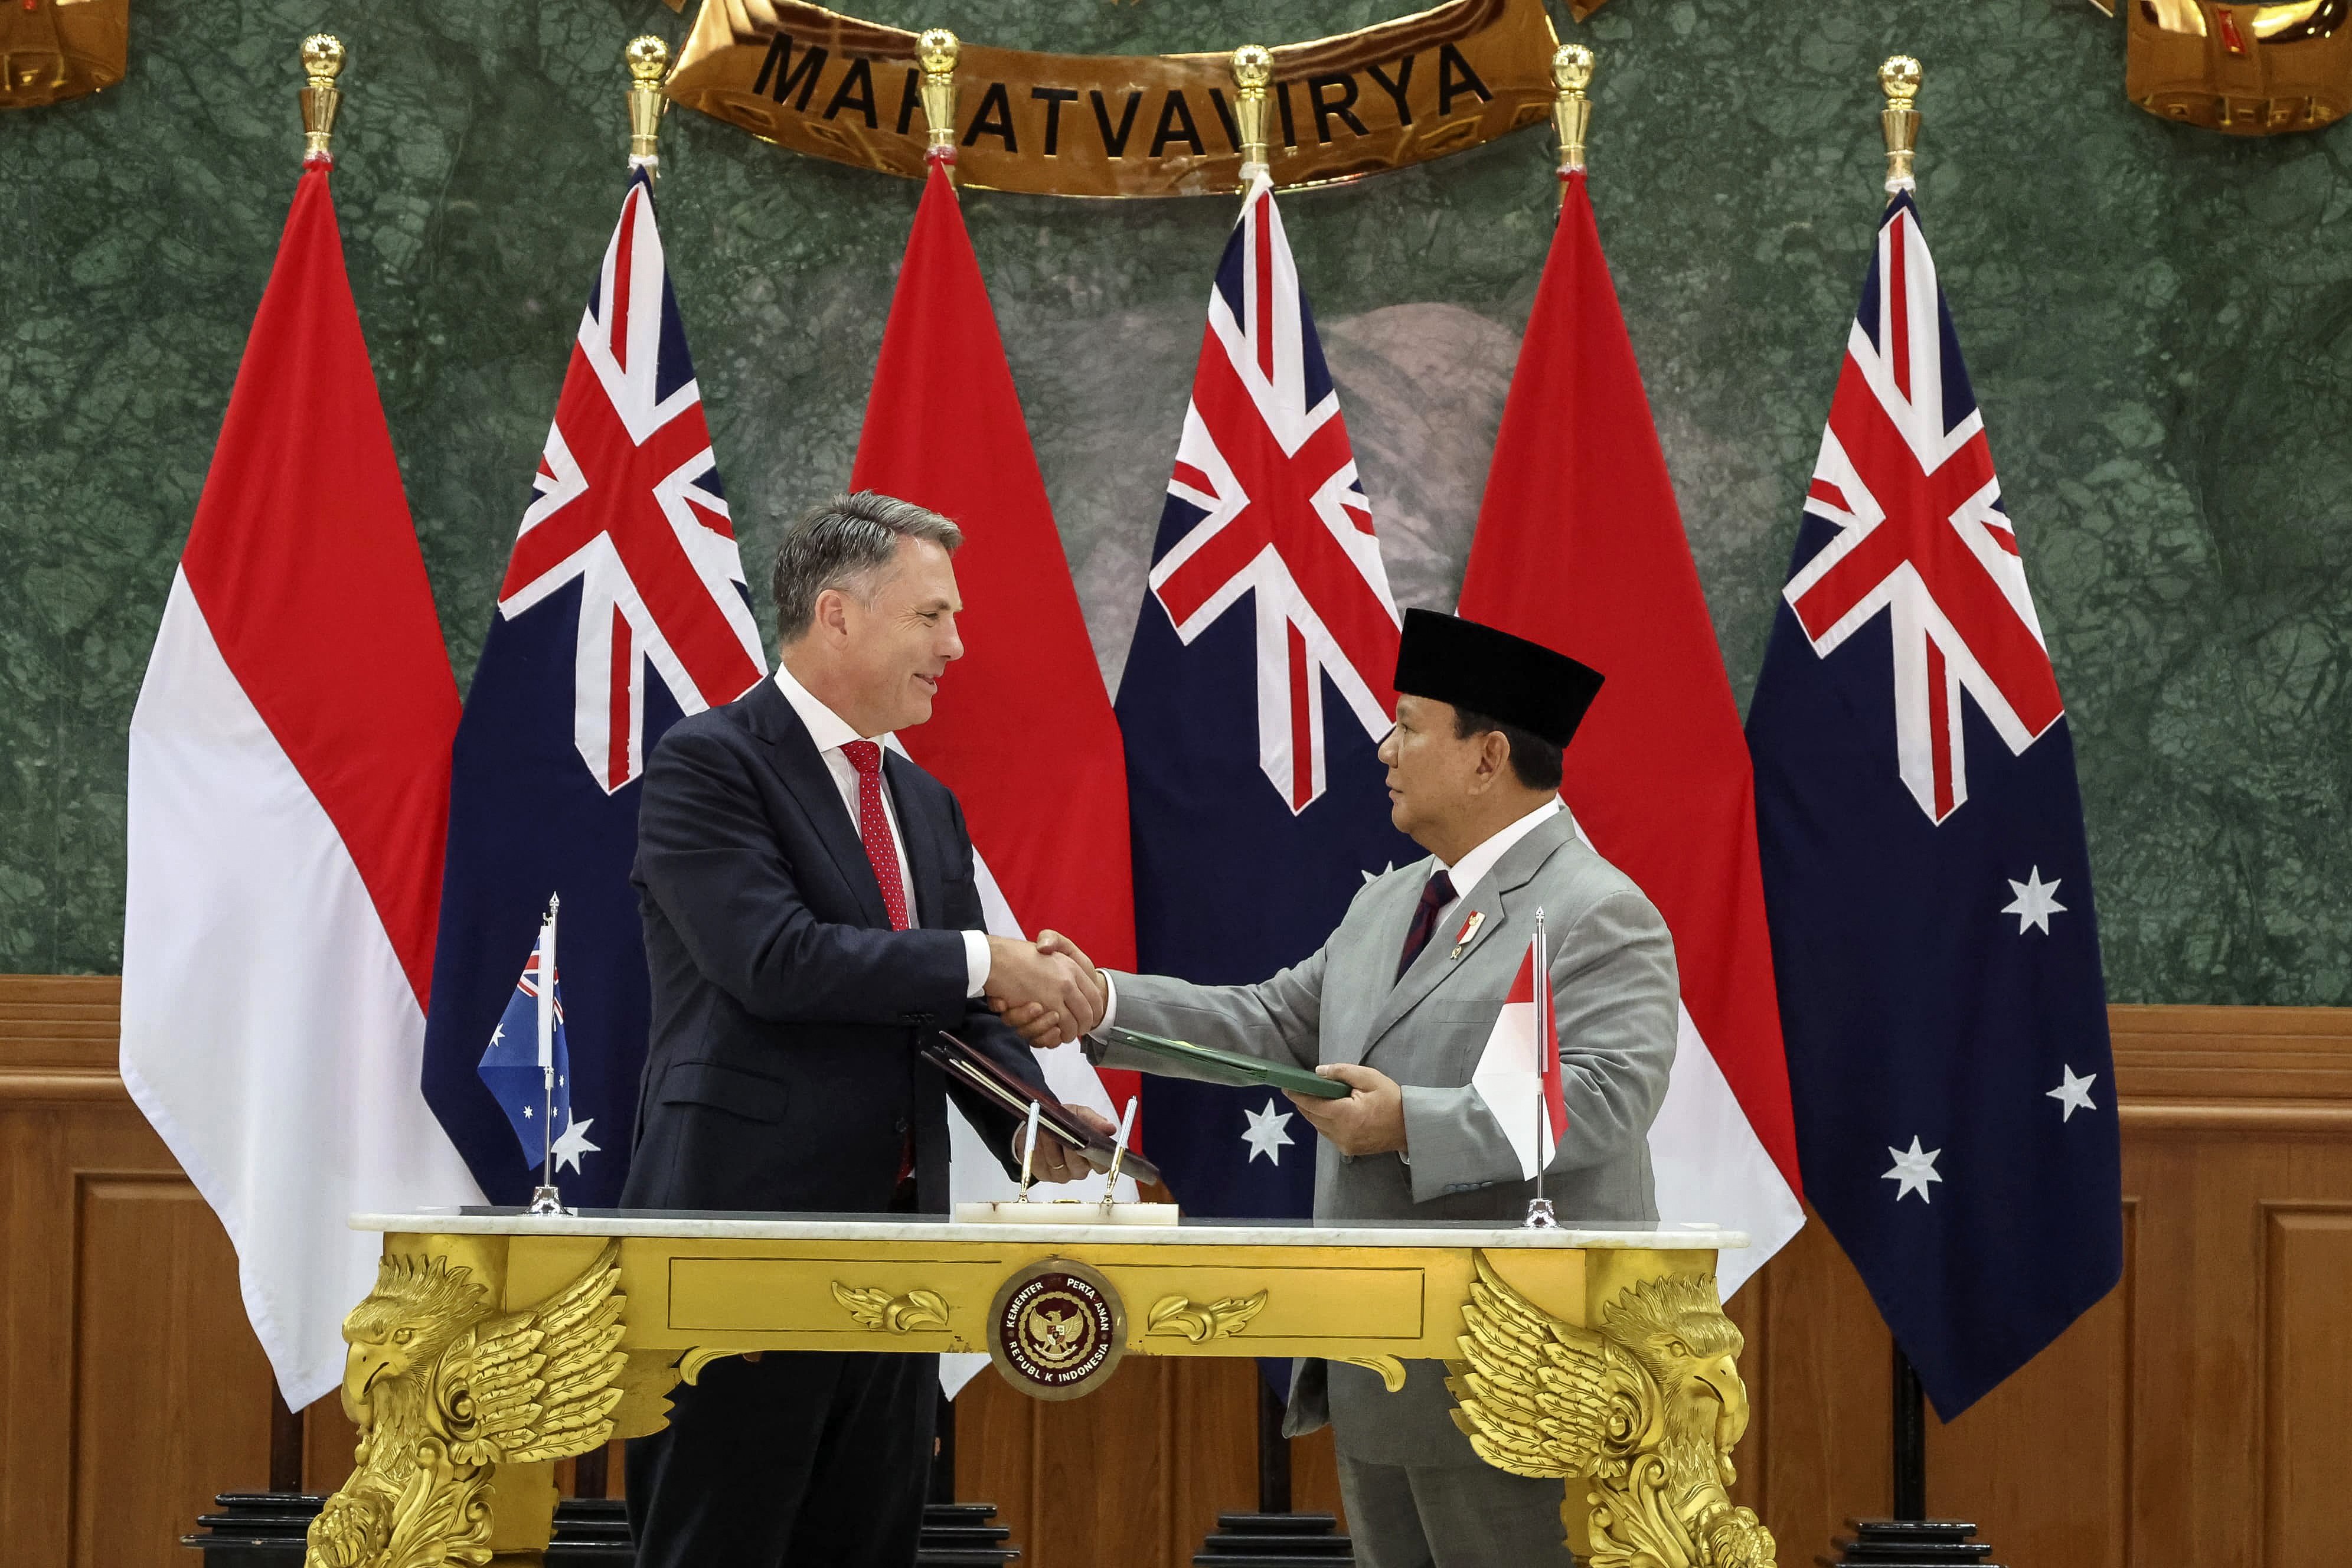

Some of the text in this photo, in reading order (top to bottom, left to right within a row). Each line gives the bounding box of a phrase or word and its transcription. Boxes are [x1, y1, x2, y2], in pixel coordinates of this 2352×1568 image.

[1067, 1278, 1109, 1331] PERTAANAN
[1009, 1341, 1109, 1383] REPUBLK INDONESIA
